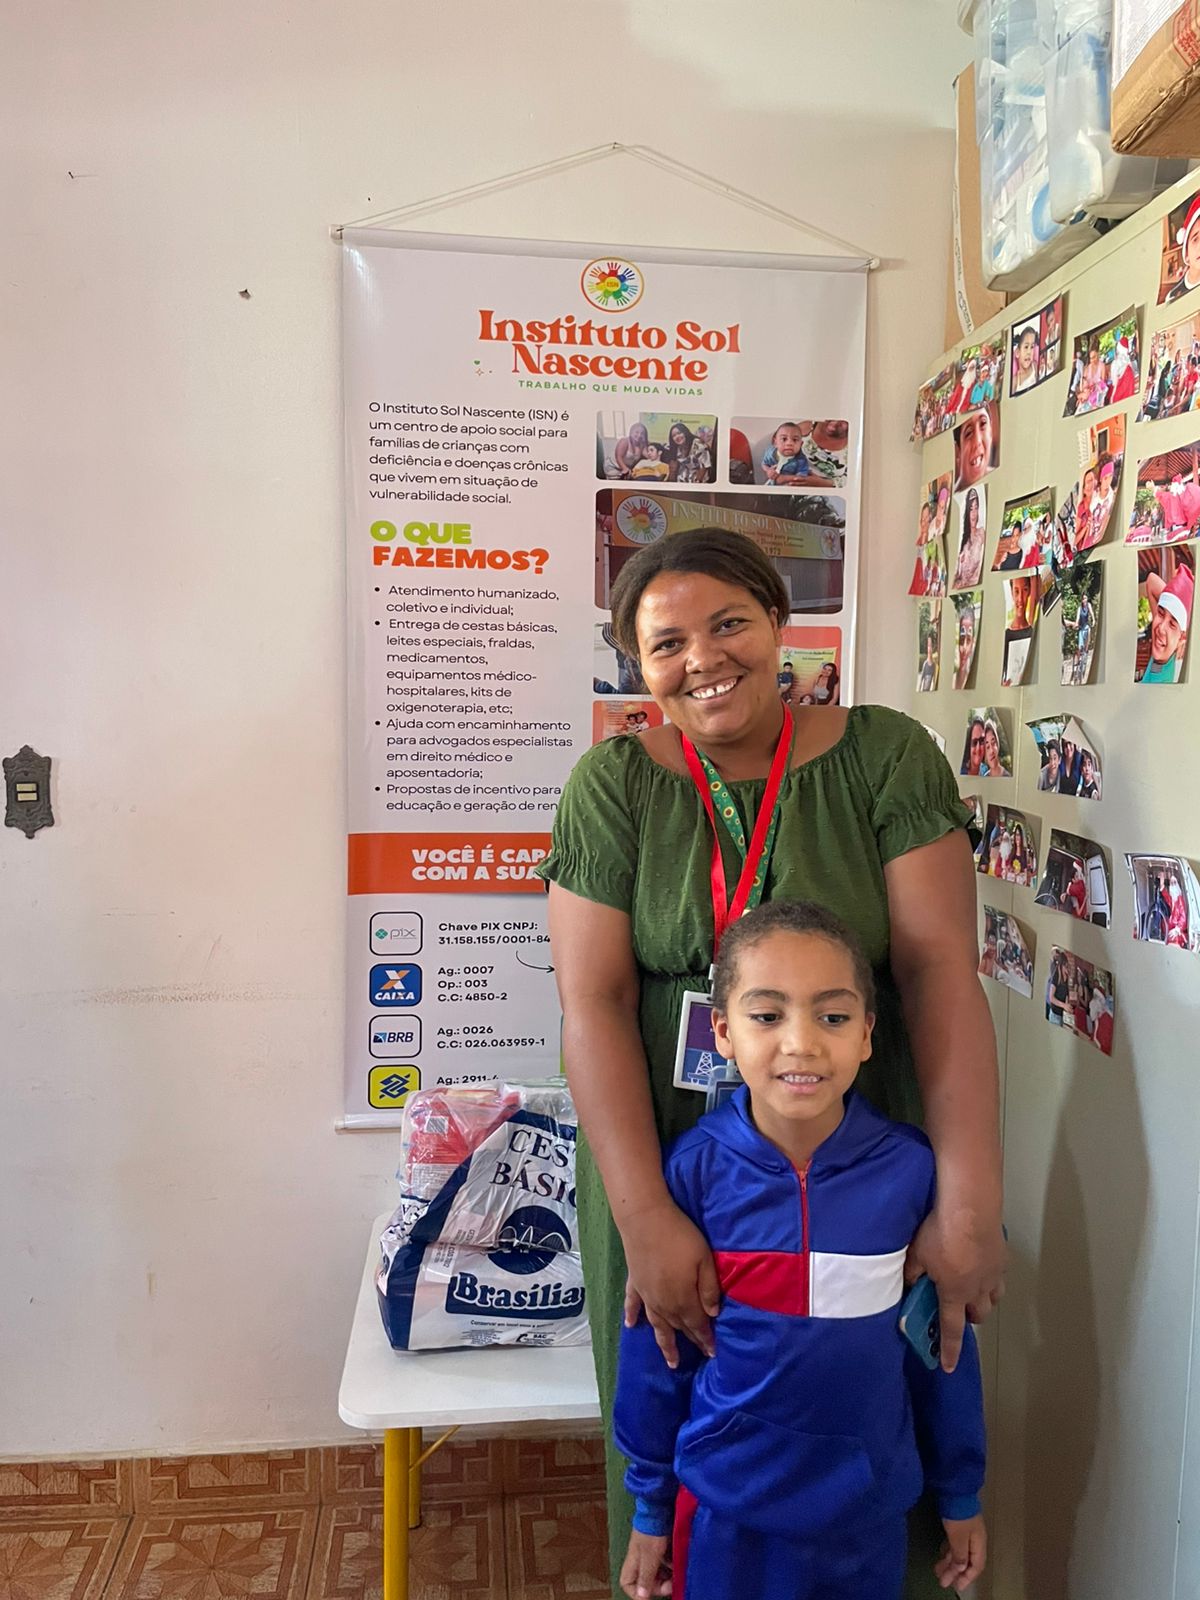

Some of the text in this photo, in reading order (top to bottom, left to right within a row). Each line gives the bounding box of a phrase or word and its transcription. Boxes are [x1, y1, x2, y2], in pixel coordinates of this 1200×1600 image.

[478, 310, 741, 353] Instituto Sol
[512, 343, 708, 382] Nascente
[519, 380, 703, 396] TRABALHO QUE MUDA VIDAS
[369, 402, 569, 421] O Instituto Sol Nascente (ISN) é
[369, 421, 568, 439] um centro de apoio social para
[422, 440, 439, 449] de
[442, 441, 497, 453] crianças
[500, 444, 529, 453] com
[369, 454, 568, 472] deficiência e doenças crônicas
[369, 472, 538, 489] que vivem em situação de
[369, 489, 511, 504] vulnerabilidade social.
[370, 521, 472, 545] O QUE
[373, 546, 550, 574] FAZEMOS?
[388, 586, 560, 600] Atendimento humanizado,
[386, 602, 514, 616] coletivo e individual;
[389, 620, 557, 634] Entrega de cestas básicas,
[386, 636, 534, 650] leites especiais, fraldas,
[387, 652, 488, 666] medicamentos,
[386, 670, 536, 683] equipamentos médico-
[387, 686, 512, 699] hospitalares, kits de
[386, 702, 513, 716] oxigenoterapia, etc;
[386, 718, 570, 731] Ajuda com encaminhamento
[386, 736, 572, 749] para advogados especialistas
[386, 752, 513, 762] em direito médico e
[386, 768, 483, 782] aposentadoria;
[386, 784, 562, 797] Propostas de incentivo para
[386, 800, 558, 814] educação e geração de ren
[412, 844, 550, 865] VOCÊ É CAP
[411, 866, 541, 881] COM A SUA
[390, 928, 416, 939] pix
[439, 922, 538, 931] Chave PIX CNPJ:
[439, 935, 550, 944] 31.158.155/0001-84
[438, 966, 494, 976] Ag.: 0007
[438, 980, 487, 989] Op.: 003
[375, 992, 415, 1000] CAIXA
[438, 993, 462, 1001] C.C:
[388, 1032, 414, 1042] BRB
[437, 1026, 493, 1037] Ag.: 0026
[437, 1038, 544, 1049] C.C: 026.063959-1
[437, 1077, 459, 1085] Ag.:
[509, 1130, 576, 1167] CES
[454, 1272, 582, 1309] Brasília
